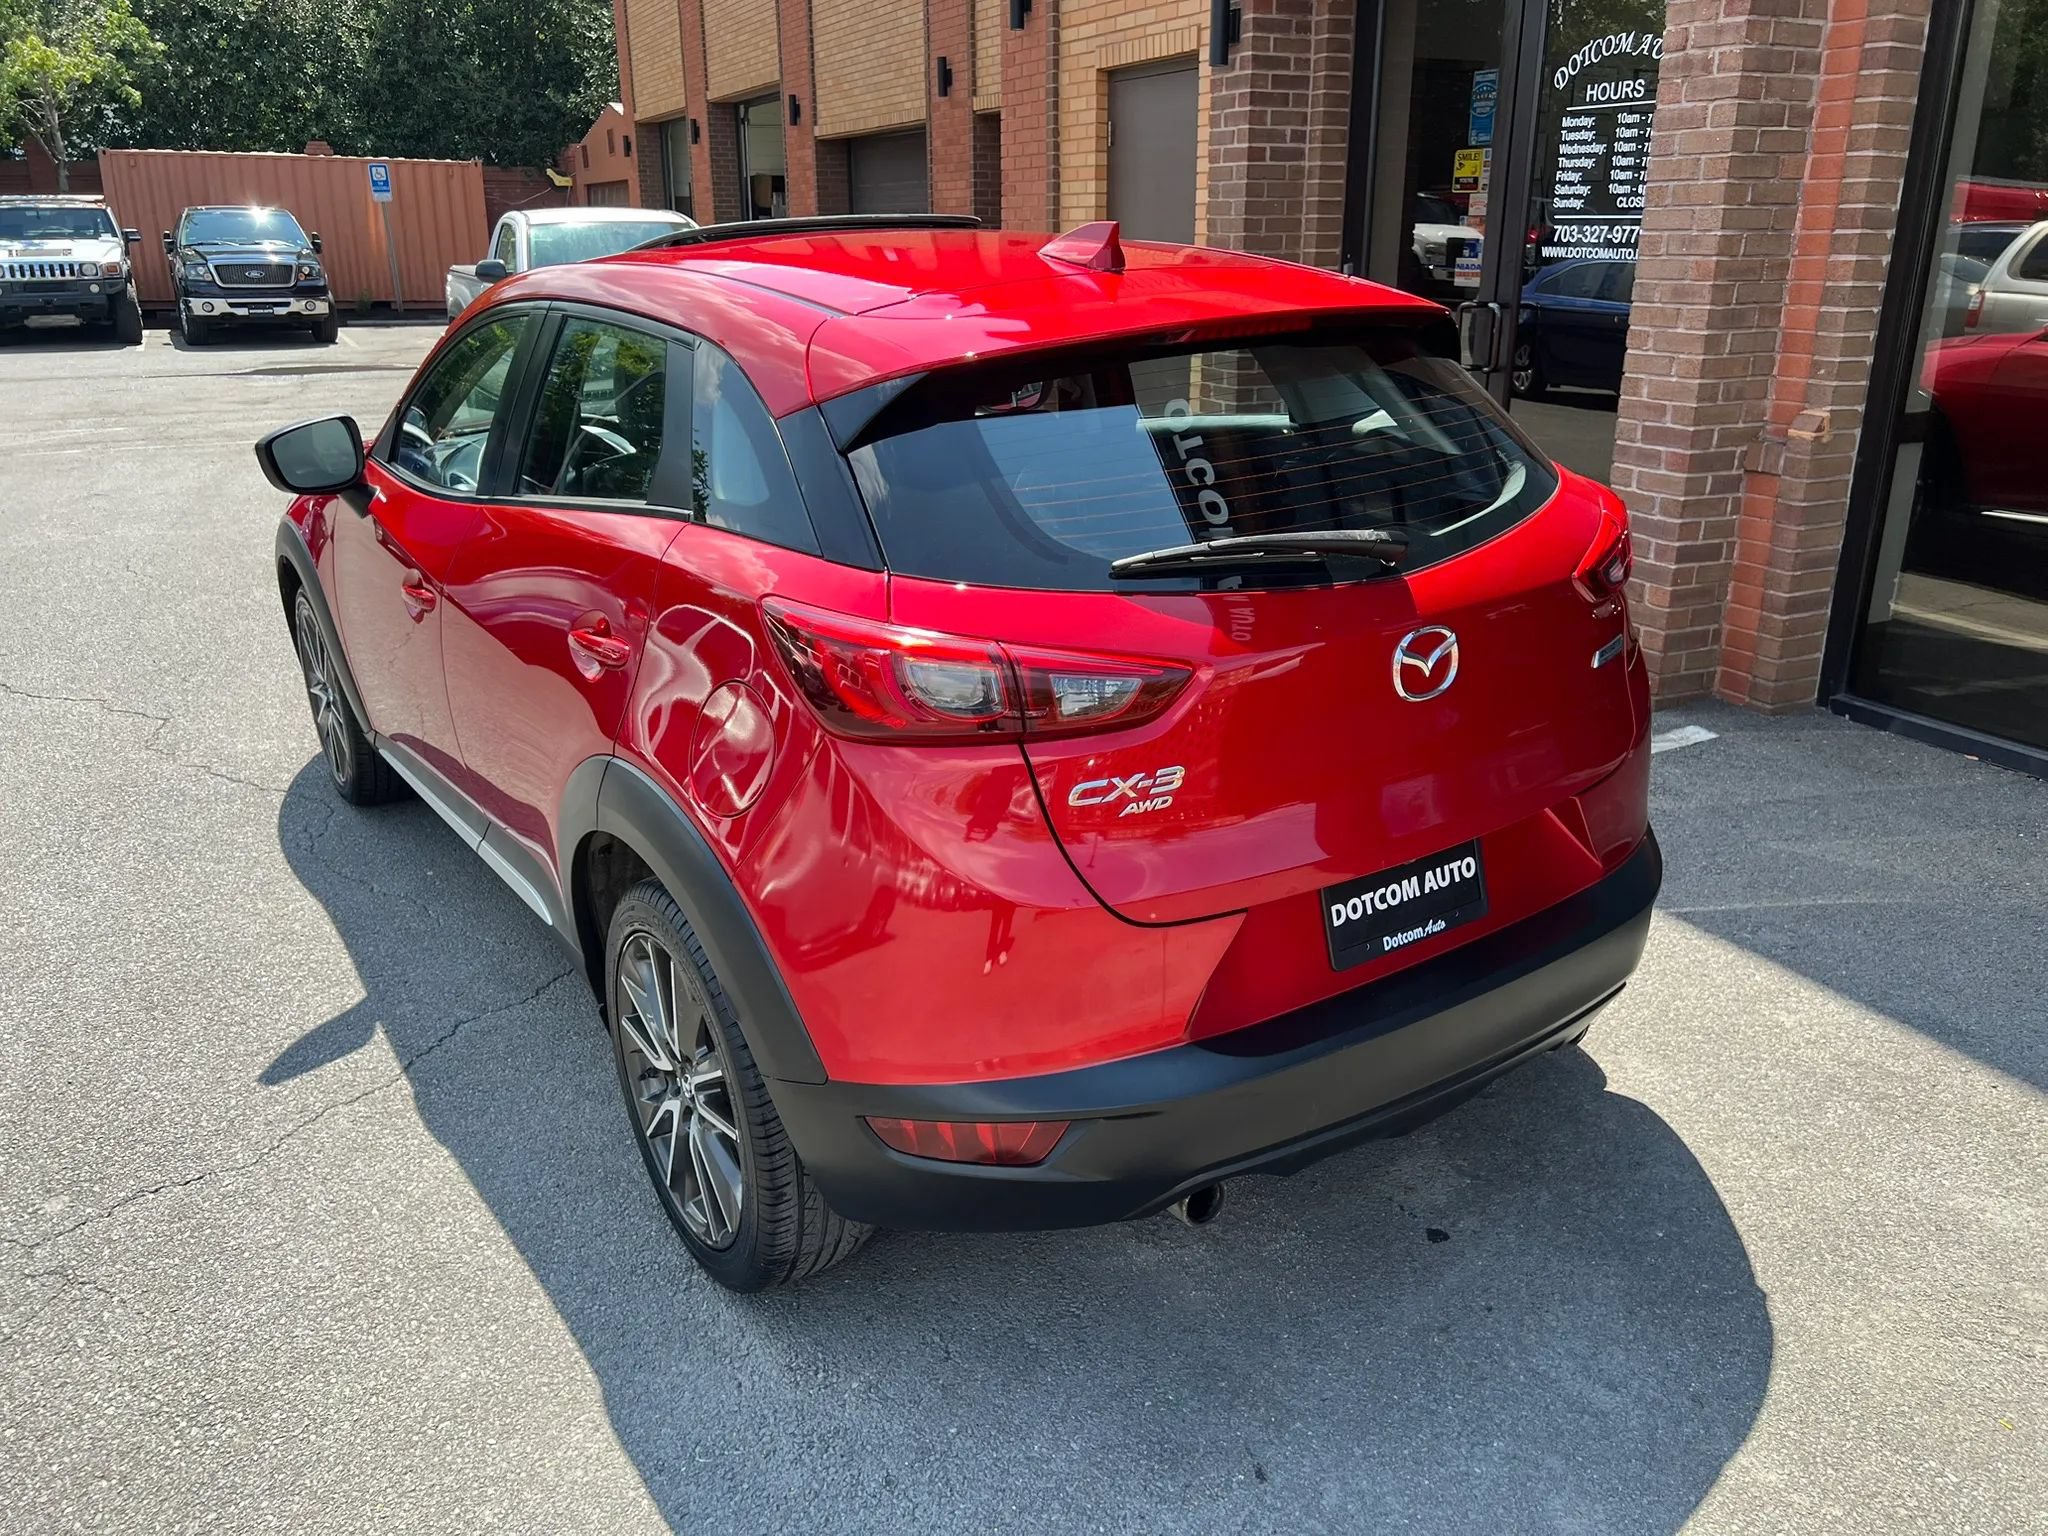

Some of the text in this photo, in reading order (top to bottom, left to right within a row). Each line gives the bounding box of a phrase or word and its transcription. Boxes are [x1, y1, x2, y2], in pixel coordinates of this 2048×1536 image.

[1554, 31, 1635, 90] DOTCOM
[1586, 79, 1645, 102] HOURS
[1562, 116, 1596, 128] Monday:
[1617, 112, 1640, 124] 10am
[1561, 129, 1596, 142] Tuesday:
[1615, 127, 1638, 138] 10am
[1559, 143, 1607, 155] Wednesday:
[1613, 141, 1636, 152] 10am
[1558, 157, 1596, 169] Thursday:
[1611, 155, 1634, 167] 10am
[1556, 171, 1582, 183] Friday:
[1609, 169, 1632, 181] 10am
[1554, 184, 1592, 197] Saturday:
[1608, 183, 1631, 194] 10am
[1553, 197, 1584, 210] Sunday:
[1068, 765, 1186, 807] CX-3
[1119, 795, 1173, 817] AWD
[1330, 856, 1477, 928] DOTCOM AUTO
[1382, 919, 1447, 952] Dotcom Auto
